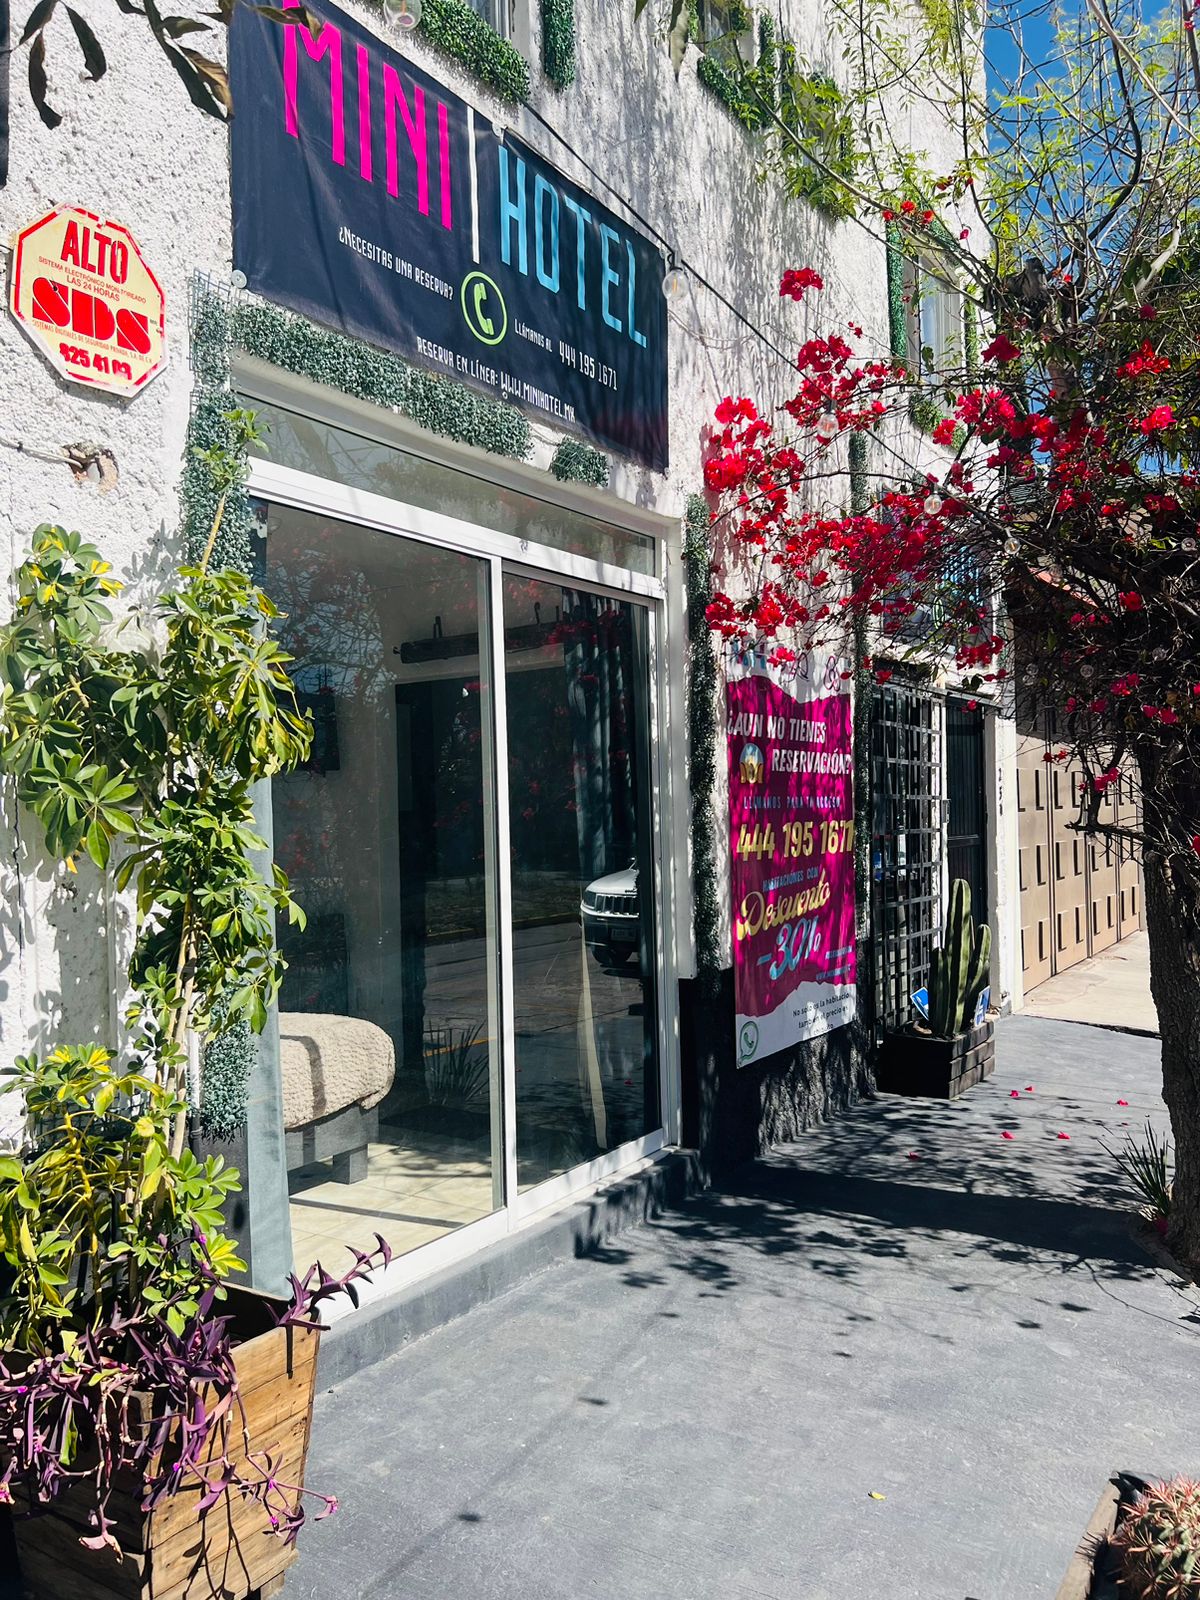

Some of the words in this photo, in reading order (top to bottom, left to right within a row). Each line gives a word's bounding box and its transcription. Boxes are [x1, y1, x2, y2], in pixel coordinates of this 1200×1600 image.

[283, 0, 452, 231] MINI
[39, 255, 63, 271] SISTEMA
[61, 220, 128, 284] ALTO
[498, 145, 647, 348] HOTEL
[67, 275, 81, 287] LAS
[83, 281, 92, 290] 24
[94, 286, 120, 301] HORAS
[395, 256, 413, 279] UNA
[415, 264, 454, 301] RESERVA?
[33, 277, 152, 354] SDS
[93, 353, 110, 374] 41
[416, 336, 454, 367] RESERVA
[456, 353, 468, 375] EN
[470, 359, 499, 386] LÍNEA:
[500, 371, 576, 423] WWW.MINIHOTEL.MX
[545, 338, 553, 353] AL
[559, 340, 577, 369] 444
[579, 351, 595, 379] 195
[598, 362, 618, 391] 1671
[766, 715, 786, 740] NO
[789, 718, 827, 744] TIENES
[771, 747, 853, 775] RESERVACIÓN?
[736, 822, 775, 861] 444
[782, 821, 814, 858] 195
[819, 818, 855, 855] 1671
[736, 867, 830, 941] Descuento
[792, 1009, 800, 1018] No
[801, 1005, 812, 1015] soo
[819, 1000, 825, 1008] la
[825, 992, 850, 1005] habitació
